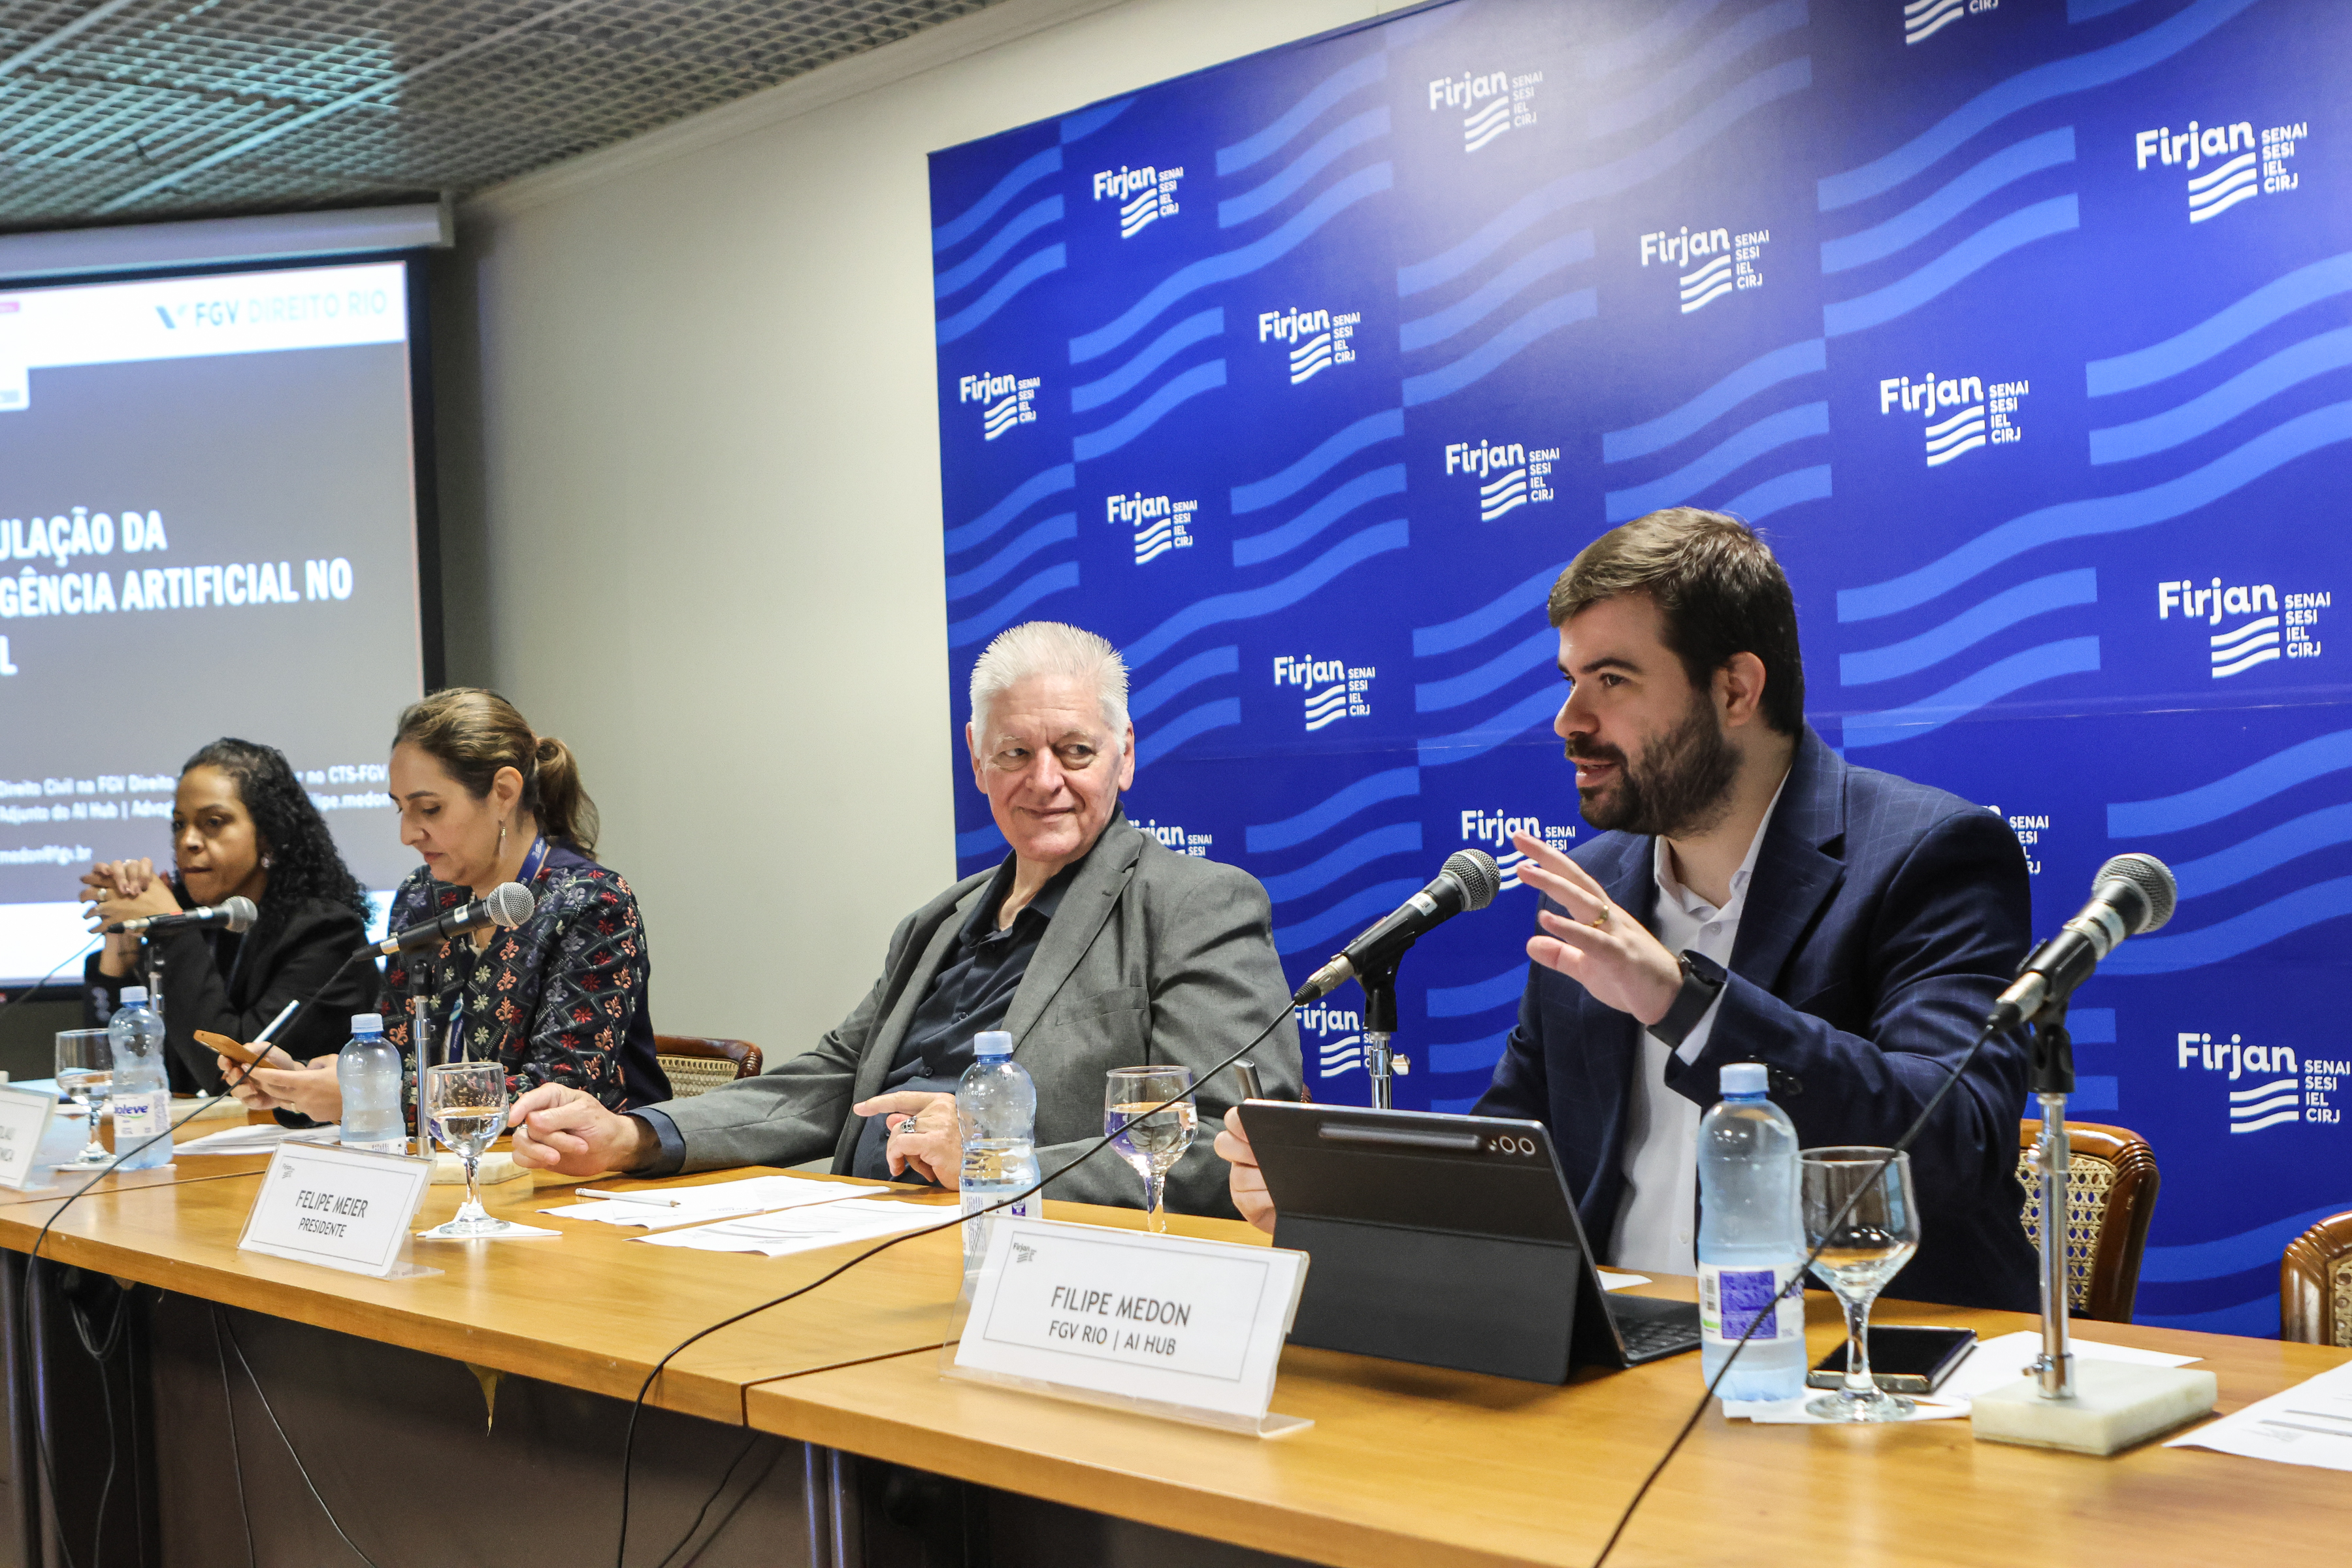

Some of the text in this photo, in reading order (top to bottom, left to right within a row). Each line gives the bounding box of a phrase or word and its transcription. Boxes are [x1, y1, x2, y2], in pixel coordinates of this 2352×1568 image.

[1512, 71, 1543, 88] SENAI
[1429, 71, 1509, 110] Firjan
[1512, 86, 1535, 101] SESI
[1513, 101, 1529, 114] IEL
[1514, 111, 1537, 127] CIRJ
[2261, 122, 2308, 145] SENAI
[2136, 120, 2256, 170] Firjan
[2262, 140, 2295, 161] SESI
[1158, 166, 1184, 182] SENAI
[2263, 159, 2287, 177] IEL
[1094, 165, 1157, 201] Firjan
[1159, 180, 1177, 193] SESI
[2264, 172, 2298, 193] CIRJ
[1160, 193, 1173, 204] IEL
[1160, 202, 1179, 216] CIRJ
[1641, 225, 1731, 267] Firjan
[1735, 229, 1770, 248] SENAI
[1735, 245, 1760, 261] SESI
[1736, 261, 1754, 276] IEL
[1737, 272, 1763, 289] CIRJ
[197, 289, 387, 327] FGV DIREITO RIO
[1259, 306, 1331, 343] Firjan
[1333, 312, 1361, 327] SENAI
[1333, 325, 1353, 339] SESI
[1334, 339, 1348, 351] IEL
[1334, 350, 1356, 363] CIRJ
[960, 371, 1017, 404] Firjan
[1017, 376, 1041, 390] SENAI
[1989, 380, 2029, 399] SENAI
[1018, 389, 1035, 401] SESI
[1880, 372, 1984, 417] Firjan
[1019, 400, 1031, 412] IEL
[1989, 397, 2018, 414] SESI
[1019, 410, 1036, 423] CIRJ
[1991, 413, 2011, 429] IEL
[1991, 426, 2021, 444] CIRJ
[1446, 439, 1526, 478] Firjan
[1529, 447, 1560, 463] SENAI
[1529, 462, 1552, 476] SESI
[1530, 476, 1546, 489] IEL
[1531, 487, 1554, 502] CIRJ
[1107, 491, 1171, 526] Firjan
[1172, 499, 1198, 513] SENAI
[1173, 512, 1191, 525] SESI
[122, 510, 167, 553] DA
[1173, 525, 1187, 536] IEL
[1174, 535, 1193, 547] CIRJ
[121, 562, 300, 611] ARTIFICIAL
[305, 557, 353, 601] NO
[2159, 577, 2278, 625] Firjan
[2285, 591, 2331, 610] SENAI
[2285, 609, 2318, 625] SESI
[2286, 626, 2310, 642] IEL
[2287, 641, 2321, 658] CIRJ
[1274, 654, 1345, 691] Firjan
[1348, 666, 1375, 679] SENAI
[1348, 679, 1368, 691] SESI
[1349, 692, 1364, 704] IEL
[1349, 704, 1371, 716] CIRJ
[1461, 809, 1541, 847] Firjan
[2009, 815, 2050, 830] SENAI
[1128, 819, 1185, 846] jan
[1188, 834, 1213, 845] SENAI
[1545, 826, 1576, 839] SENAI
[2015, 830, 2038, 844] ESI
[1188, 846, 1206, 857] SESI
[1546, 840, 1567, 851] SESI
[2178, 1032, 2298, 1080] Firjan
[2304, 1059, 2351, 1075] SENAI
[2305, 1075, 2337, 1091] SESI
[2306, 1091, 2329, 1107] IEL
[2306, 1107, 2340, 1123] CIRJ
[296, 1190, 368, 1218] FELIPE MEIER
[299, 1217, 347, 1237] PRESIDENTE
[1051, 1286, 1191, 1328] FILIPE MEDON
[1048, 1320, 1079, 1341] FGV
[1081, 1326, 1107, 1345] RIO
[1124, 1332, 1139, 1349] AI
[1144, 1335, 1177, 1356] HUB
